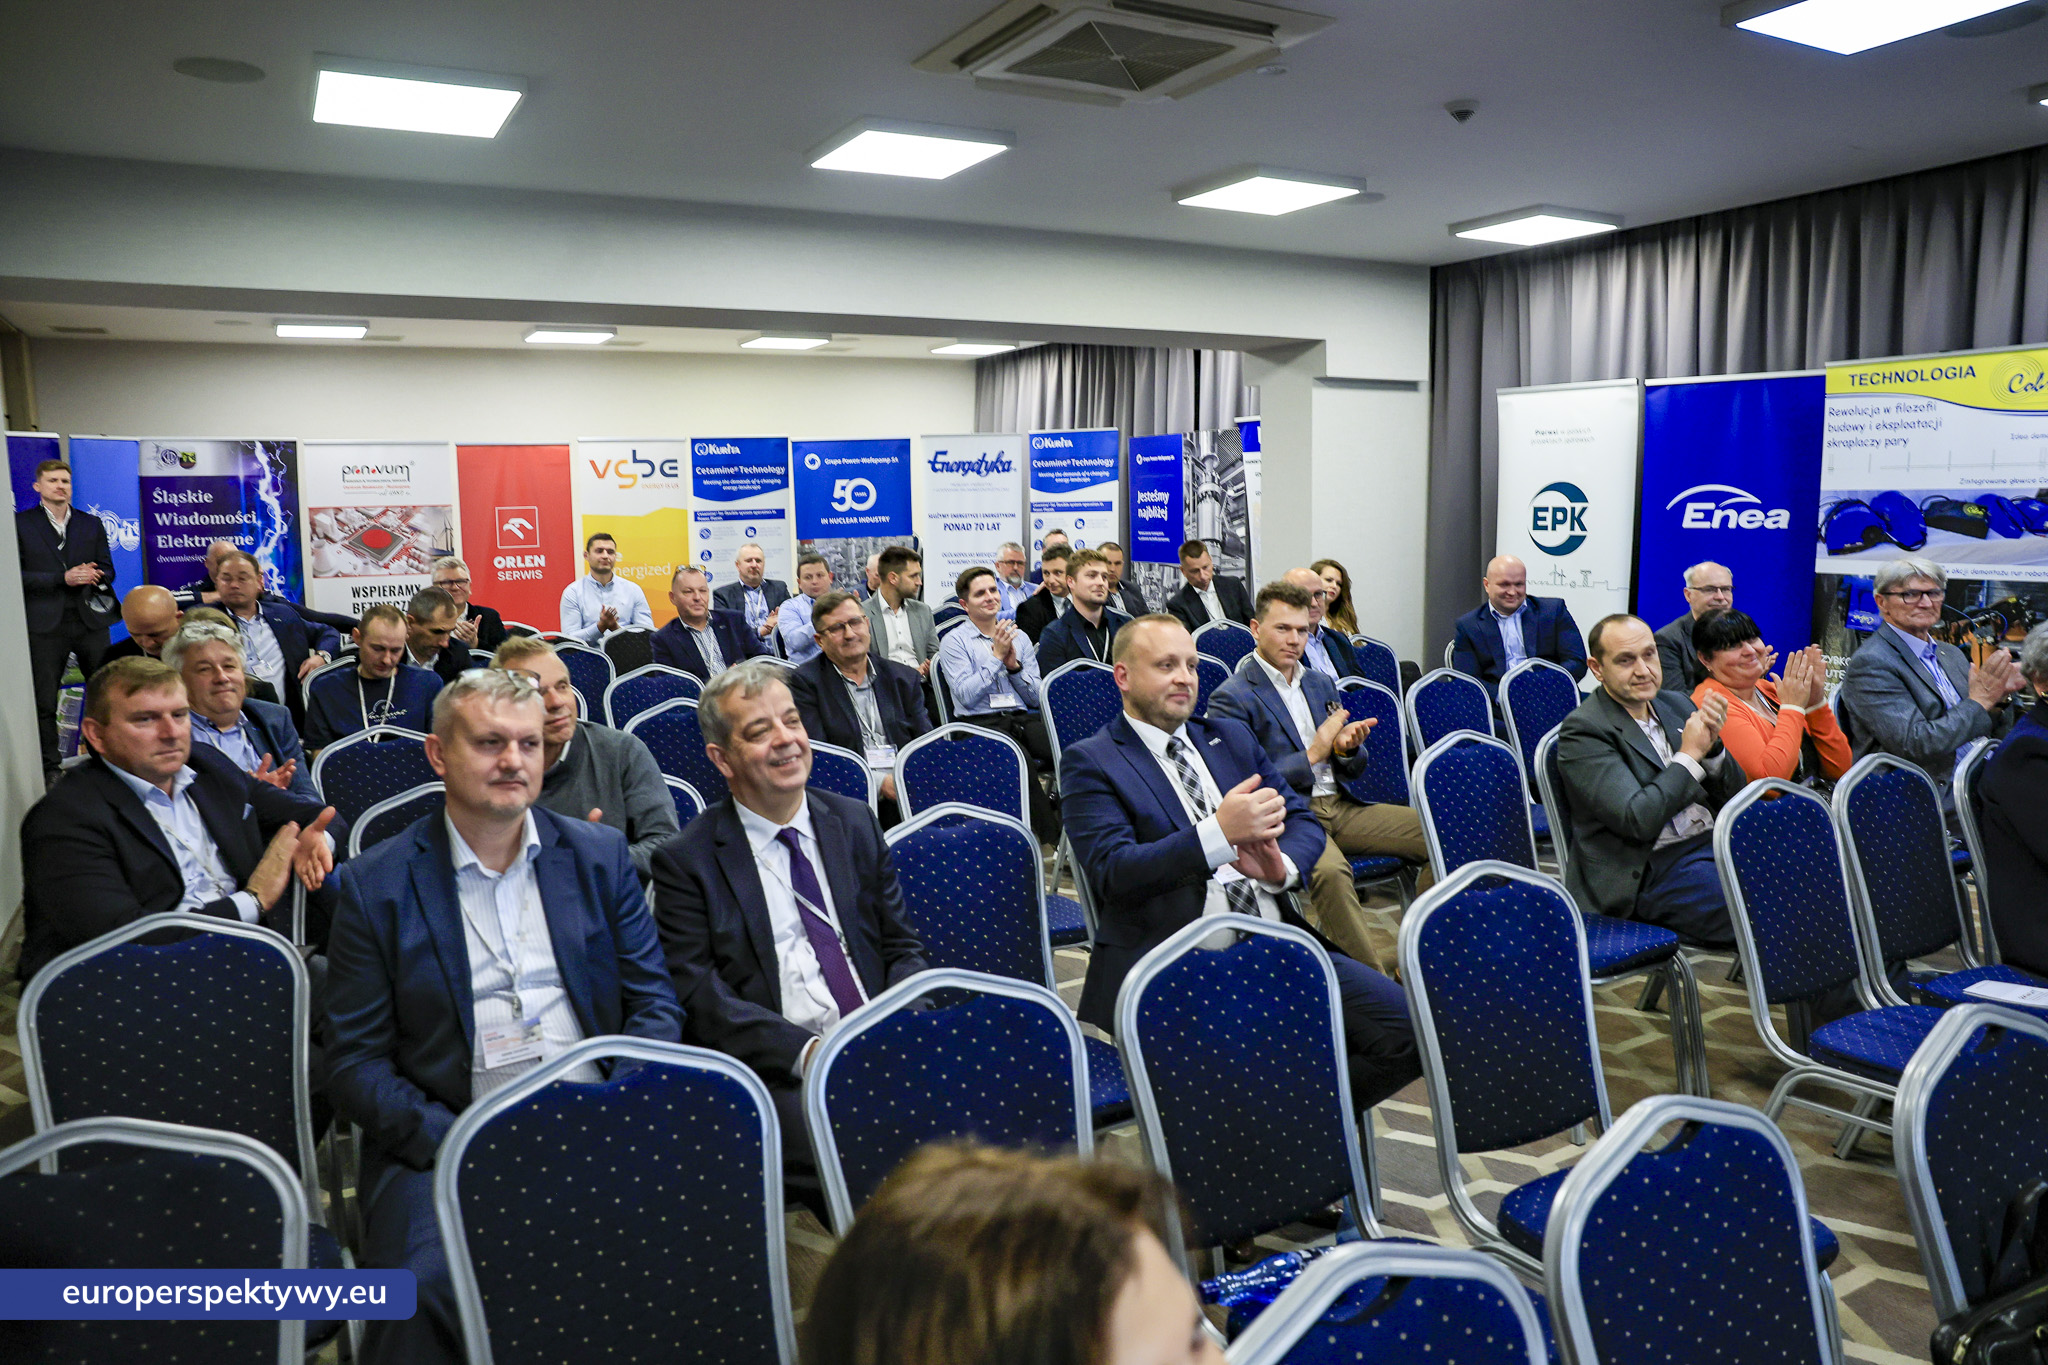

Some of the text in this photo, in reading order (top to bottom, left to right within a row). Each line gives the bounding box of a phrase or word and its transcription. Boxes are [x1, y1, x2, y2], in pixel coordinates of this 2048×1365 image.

[1849, 366, 1976, 387] TECHNOLOGIA
[1828, 401, 1937, 418] Rewolucja w filozofii
[1828, 422, 1865, 435] budowy
[1875, 417, 1943, 432] eksploatacji
[1827, 437, 1909, 450] skraplaczy pary
[739, 465, 786, 475] Technology
[928, 450, 1013, 477] Energetyka
[1071, 457, 1114, 467] Technology
[152, 487, 213, 507] Śląskie
[831, 477, 877, 512] 50
[1137, 489, 1170, 505] Jesteśmy
[154, 510, 257, 527] Wiadomości
[829, 516, 858, 524] NUCLEAR
[859, 515, 890, 524] INDUSTRY
[1137, 505, 1168, 521] najbliżej
[1532, 505, 1589, 532] EPK
[1682, 502, 1791, 530] Enea
[943, 522, 1001, 531] PONAD 70 LAT
[157, 554, 206, 563] dwumiesięc
[493, 555, 546, 569] ORLEN
[497, 569, 543, 581] SERWIS
[614, 563, 671, 580] nergized
[351, 584, 421, 598] WSPIERAMY
